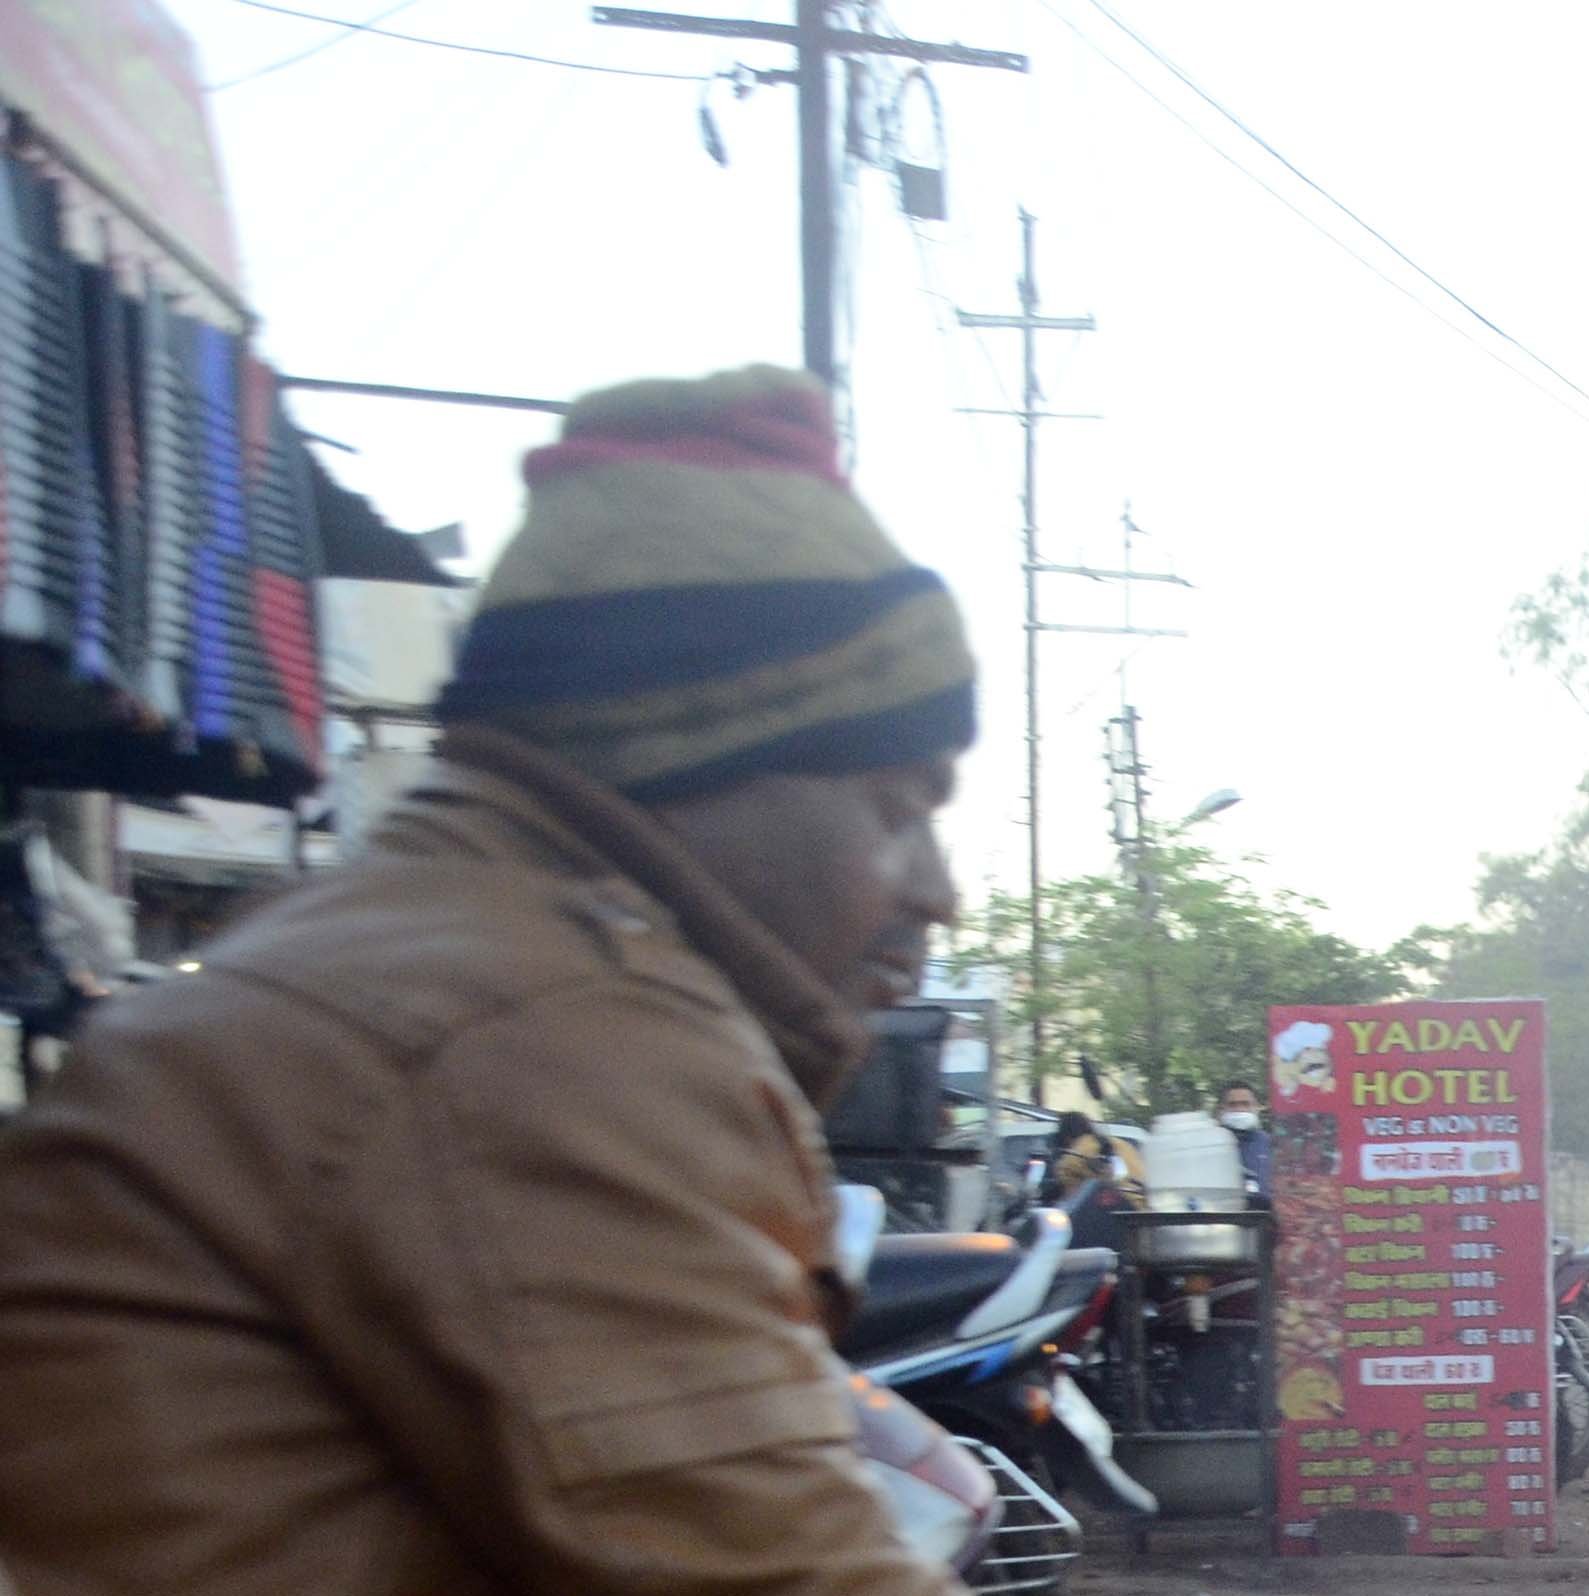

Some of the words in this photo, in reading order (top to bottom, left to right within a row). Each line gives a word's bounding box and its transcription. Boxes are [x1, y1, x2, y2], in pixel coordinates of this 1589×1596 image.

[1346, 1018, 1526, 1055] YADAV
[1353, 1069, 1519, 1106] HOTEL
[1362, 1116, 1404, 1136] VEG
[1428, 1115, 1478, 1135] NON
[1481, 1115, 1521, 1134] VEG
